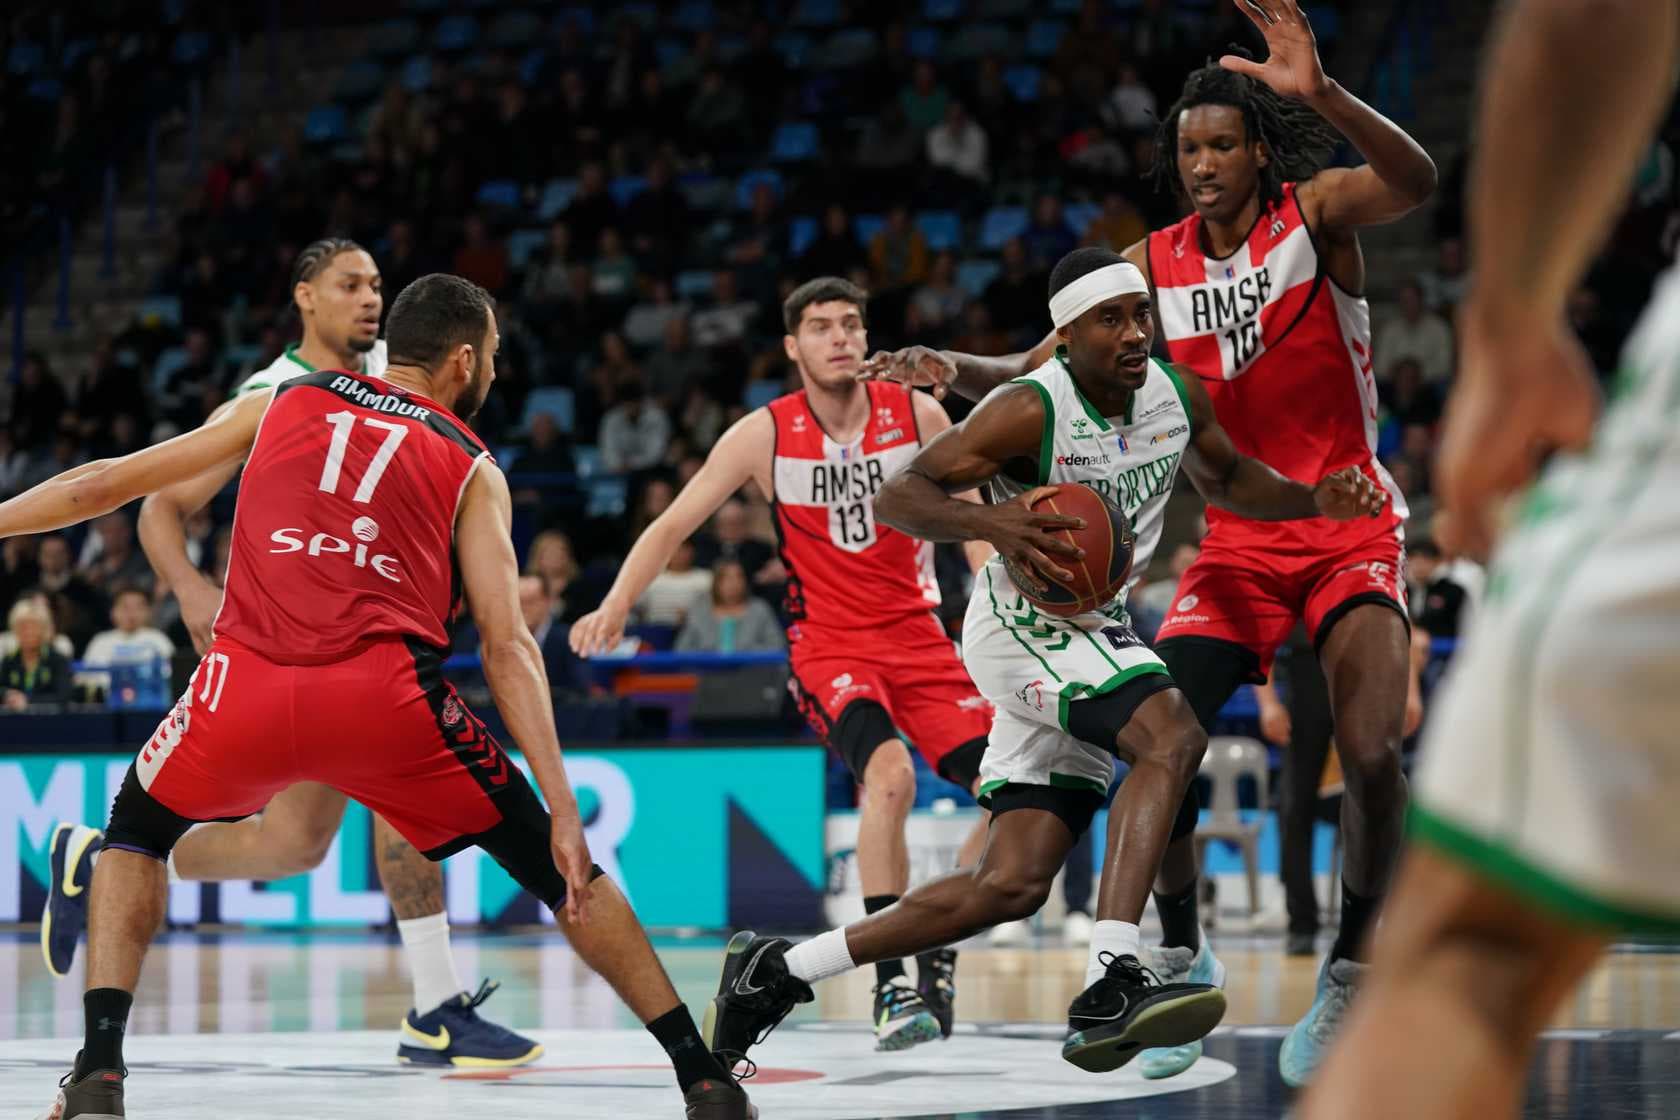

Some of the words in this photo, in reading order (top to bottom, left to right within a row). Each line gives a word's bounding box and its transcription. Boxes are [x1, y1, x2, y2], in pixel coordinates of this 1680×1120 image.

[1191, 267, 1273, 332] AMSB
[1224, 320, 1259, 371] 10
[318, 410, 409, 504] 17
[835, 503, 869, 545] 13
[199, 652, 230, 713] 17
